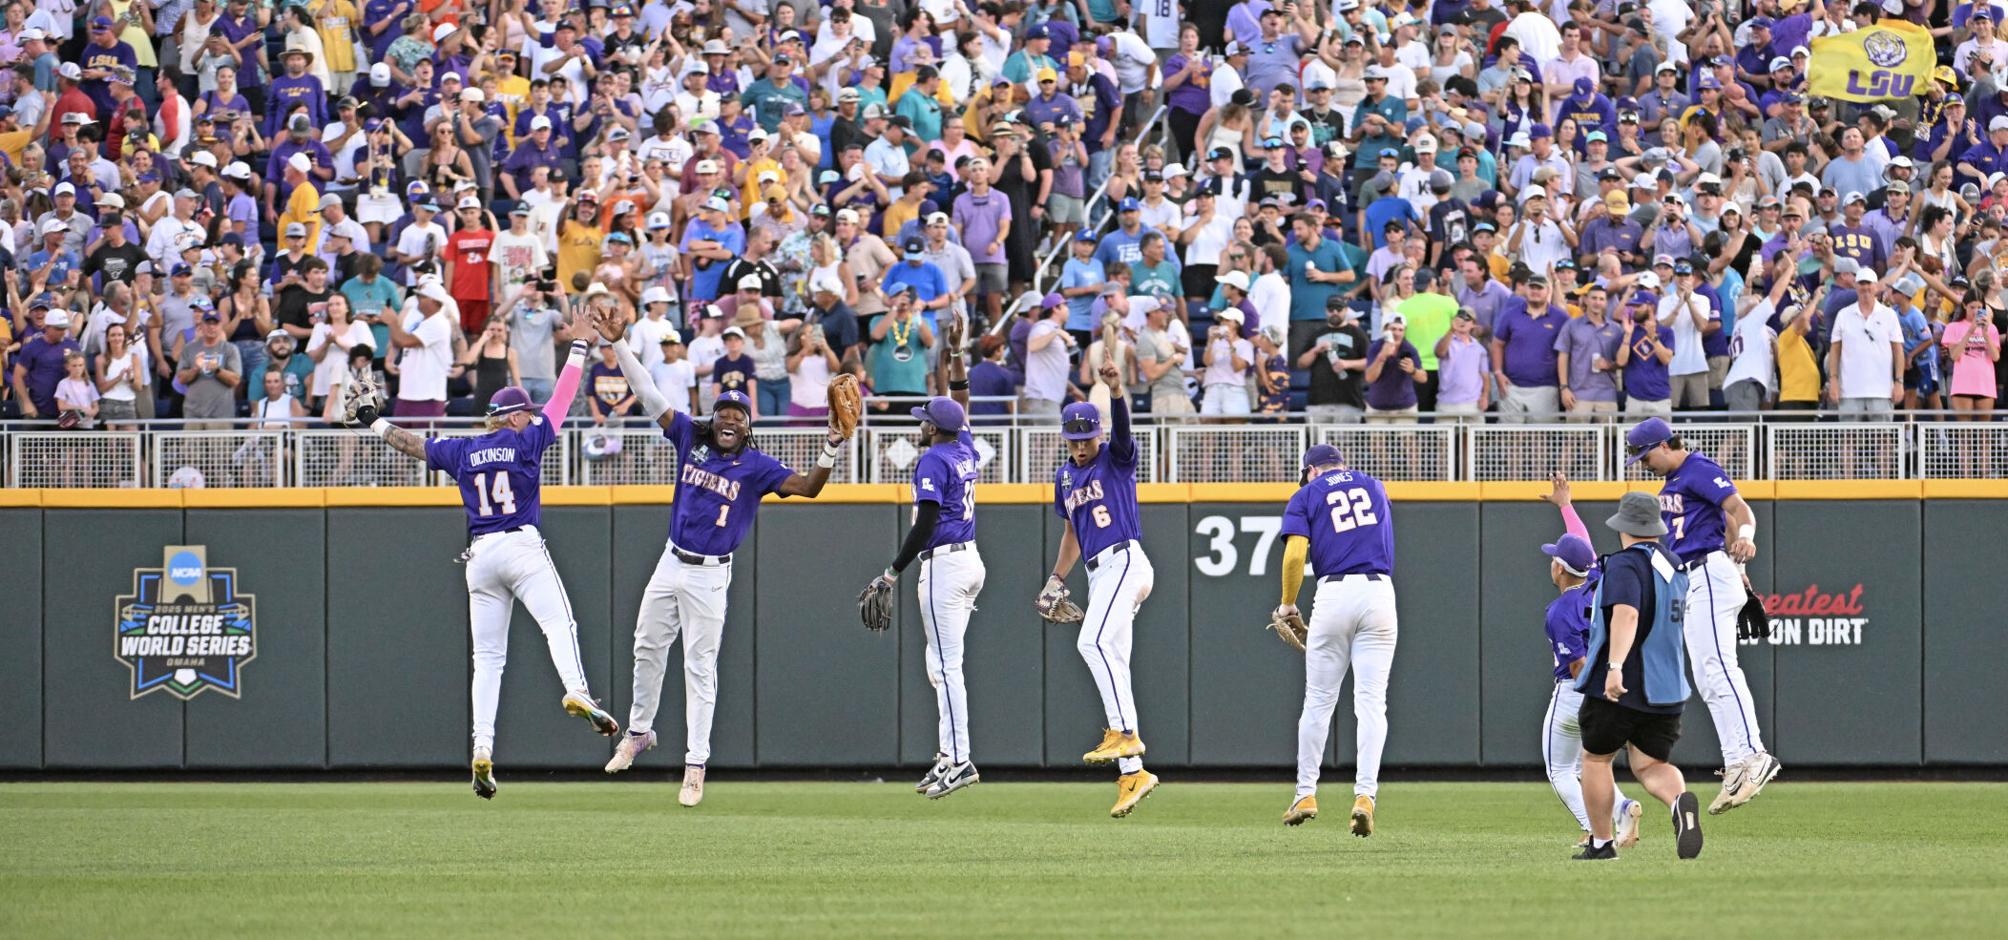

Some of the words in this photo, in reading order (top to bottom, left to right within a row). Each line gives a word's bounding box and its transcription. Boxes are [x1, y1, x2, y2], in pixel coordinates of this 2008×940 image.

[1155, 0, 1170, 17] 18
[1845, 69, 1915, 97] LSU
[1835, 233, 1872, 249] LSU
[470, 447, 515, 467] DICKINSON
[680, 463, 741, 502] TIGERS
[1325, 471, 1354, 487] JONES
[473, 470, 517, 517] 14
[715, 504, 730, 528] 1
[1092, 504, 1112, 529] 6
[1326, 487, 1378, 534] 22
[1671, 516, 1686, 540] 7
[1194, 515, 1315, 578] 37
[171, 567, 202, 578] NCAA
[184, 605, 216, 613] MEN'S
[1755, 584, 1864, 616] eatest
[147, 615, 224, 635] COLLEGE
[1767, 619, 1802, 646] ON
[1808, 619, 1866, 646] DIRT
[121, 636, 186, 656] WORLD
[186, 636, 251, 656] SERIES
[166, 658, 205, 667] OMAHA
